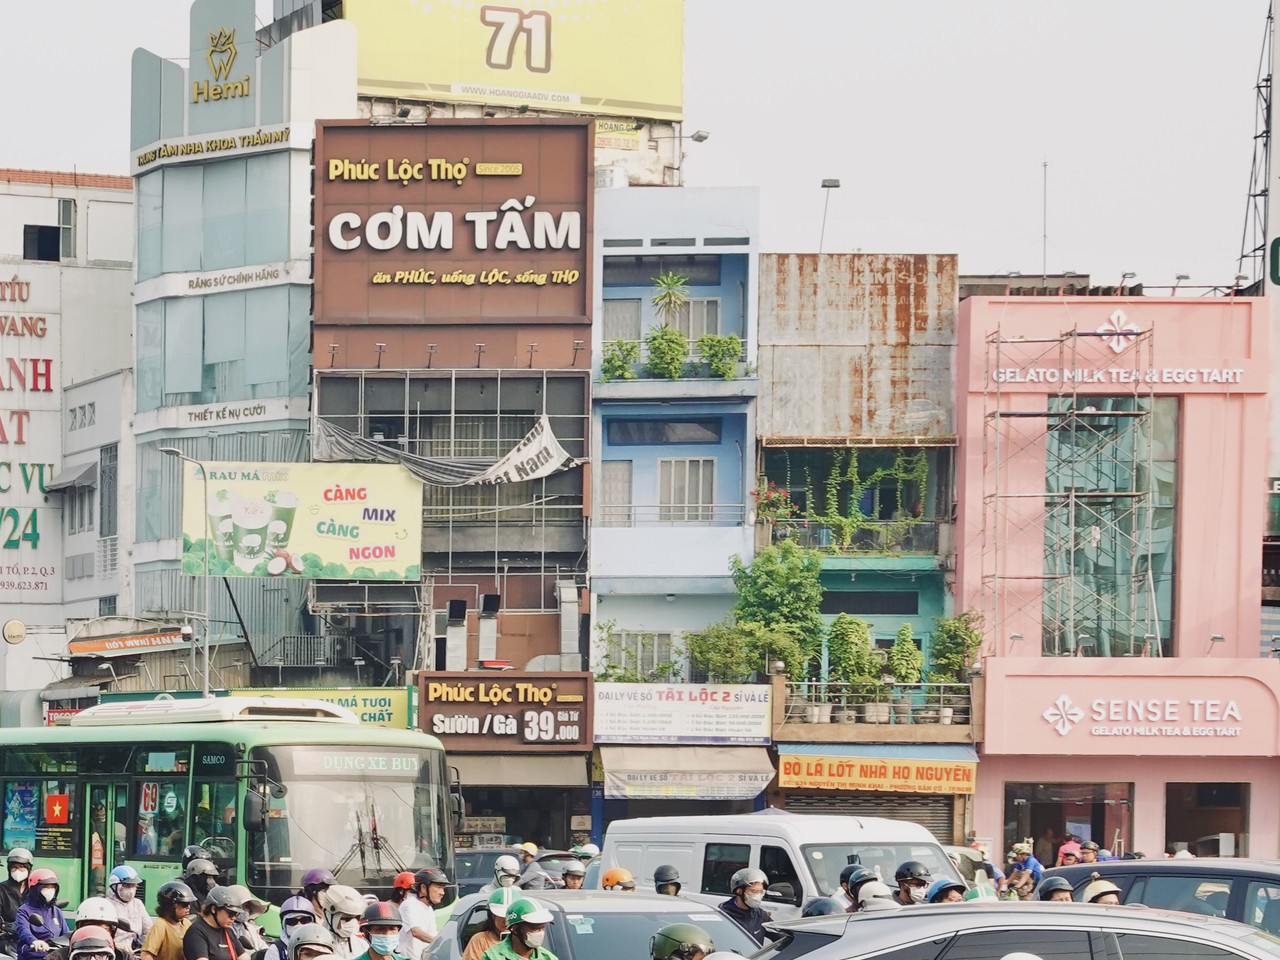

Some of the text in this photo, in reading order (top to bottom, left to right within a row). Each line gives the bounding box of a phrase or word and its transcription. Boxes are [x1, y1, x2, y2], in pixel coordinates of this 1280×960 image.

[480, 5, 552, 73] 71
[193, 75, 250, 103] Hemi
[461, 86, 570, 103] WWW.HOANGGIAADV.COM
[180, 142, 203, 155] NHA
[206, 137, 237, 152] KHOA
[328, 158, 468, 187] Phúc Lộc Thọ
[478, 164, 521, 174] Since 2005
[328, 195, 581, 250] CƠM TẤM
[188, 278, 213, 290] RĂNG
[227, 272, 254, 285] CHÍNH
[373, 268, 580, 286] ăn PHÚC, uống LỘC, sống THỌ
[993, 368, 1245, 384] GELATO MILK TEA & EGG TART
[188, 408, 213, 422] THIẾT
[216, 406, 227, 420] KẾ
[243, 404, 266, 416] CƯỜI
[514, 445, 554, 480] Nam
[20, 462, 55, 502] VỤ
[209, 471, 238, 481] RAU
[240, 469, 261, 481] MÁ
[323, 484, 368, 502] CÀNG
[362, 507, 396, 522] MIX
[316, 519, 360, 538] CÀNG
[349, 545, 396, 560] NGON
[361, 696, 392, 708] TƯƠI
[428, 682, 553, 707] Phúc Lộc Thọ
[656, 688, 684, 701] TÀI
[688, 688, 718, 705] LỘC
[721, 691, 731, 702] 2
[360, 711, 394, 722] CHẤT
[1091, 698, 1243, 722] SENSE TEA
[1092, 726, 1242, 737] GELATO MILK TEA & EGG TART
[202, 755, 225, 764] SAMCO
[367, 756, 387, 770] XE
[783, 757, 971, 783] BÒ LÁ LỐT NHÀ HỌ NGUYỄN
[143, 783, 158, 811] 69
